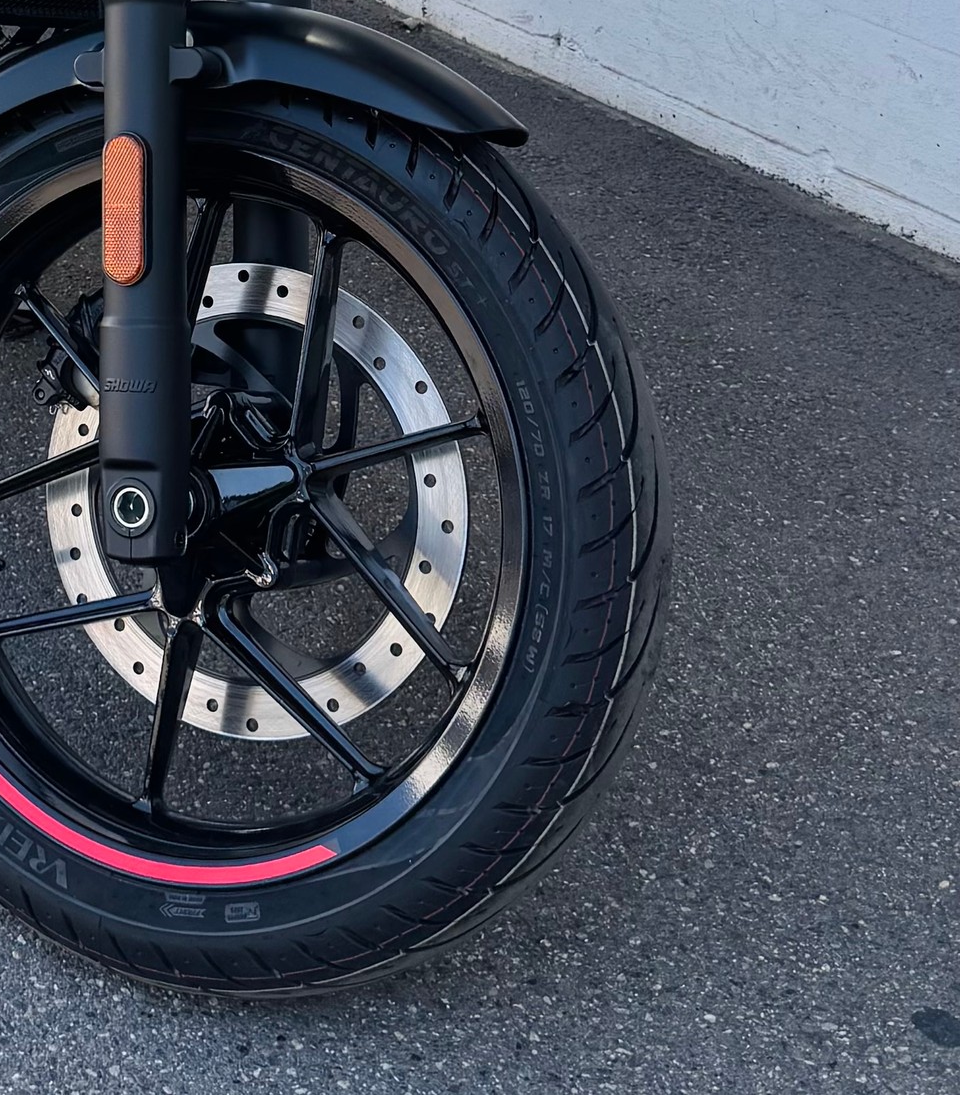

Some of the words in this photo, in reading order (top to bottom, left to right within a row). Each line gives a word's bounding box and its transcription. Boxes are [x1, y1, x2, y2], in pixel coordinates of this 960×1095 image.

[269, 125, 451, 255] CENTAURO
[104, 378, 158, 393] SHOWA
[516, 379, 545, 457] 120/70
[538, 471, 552, 501] ZR
[542, 516, 553, 537] 17
[540, 549, 553, 598] M/C
